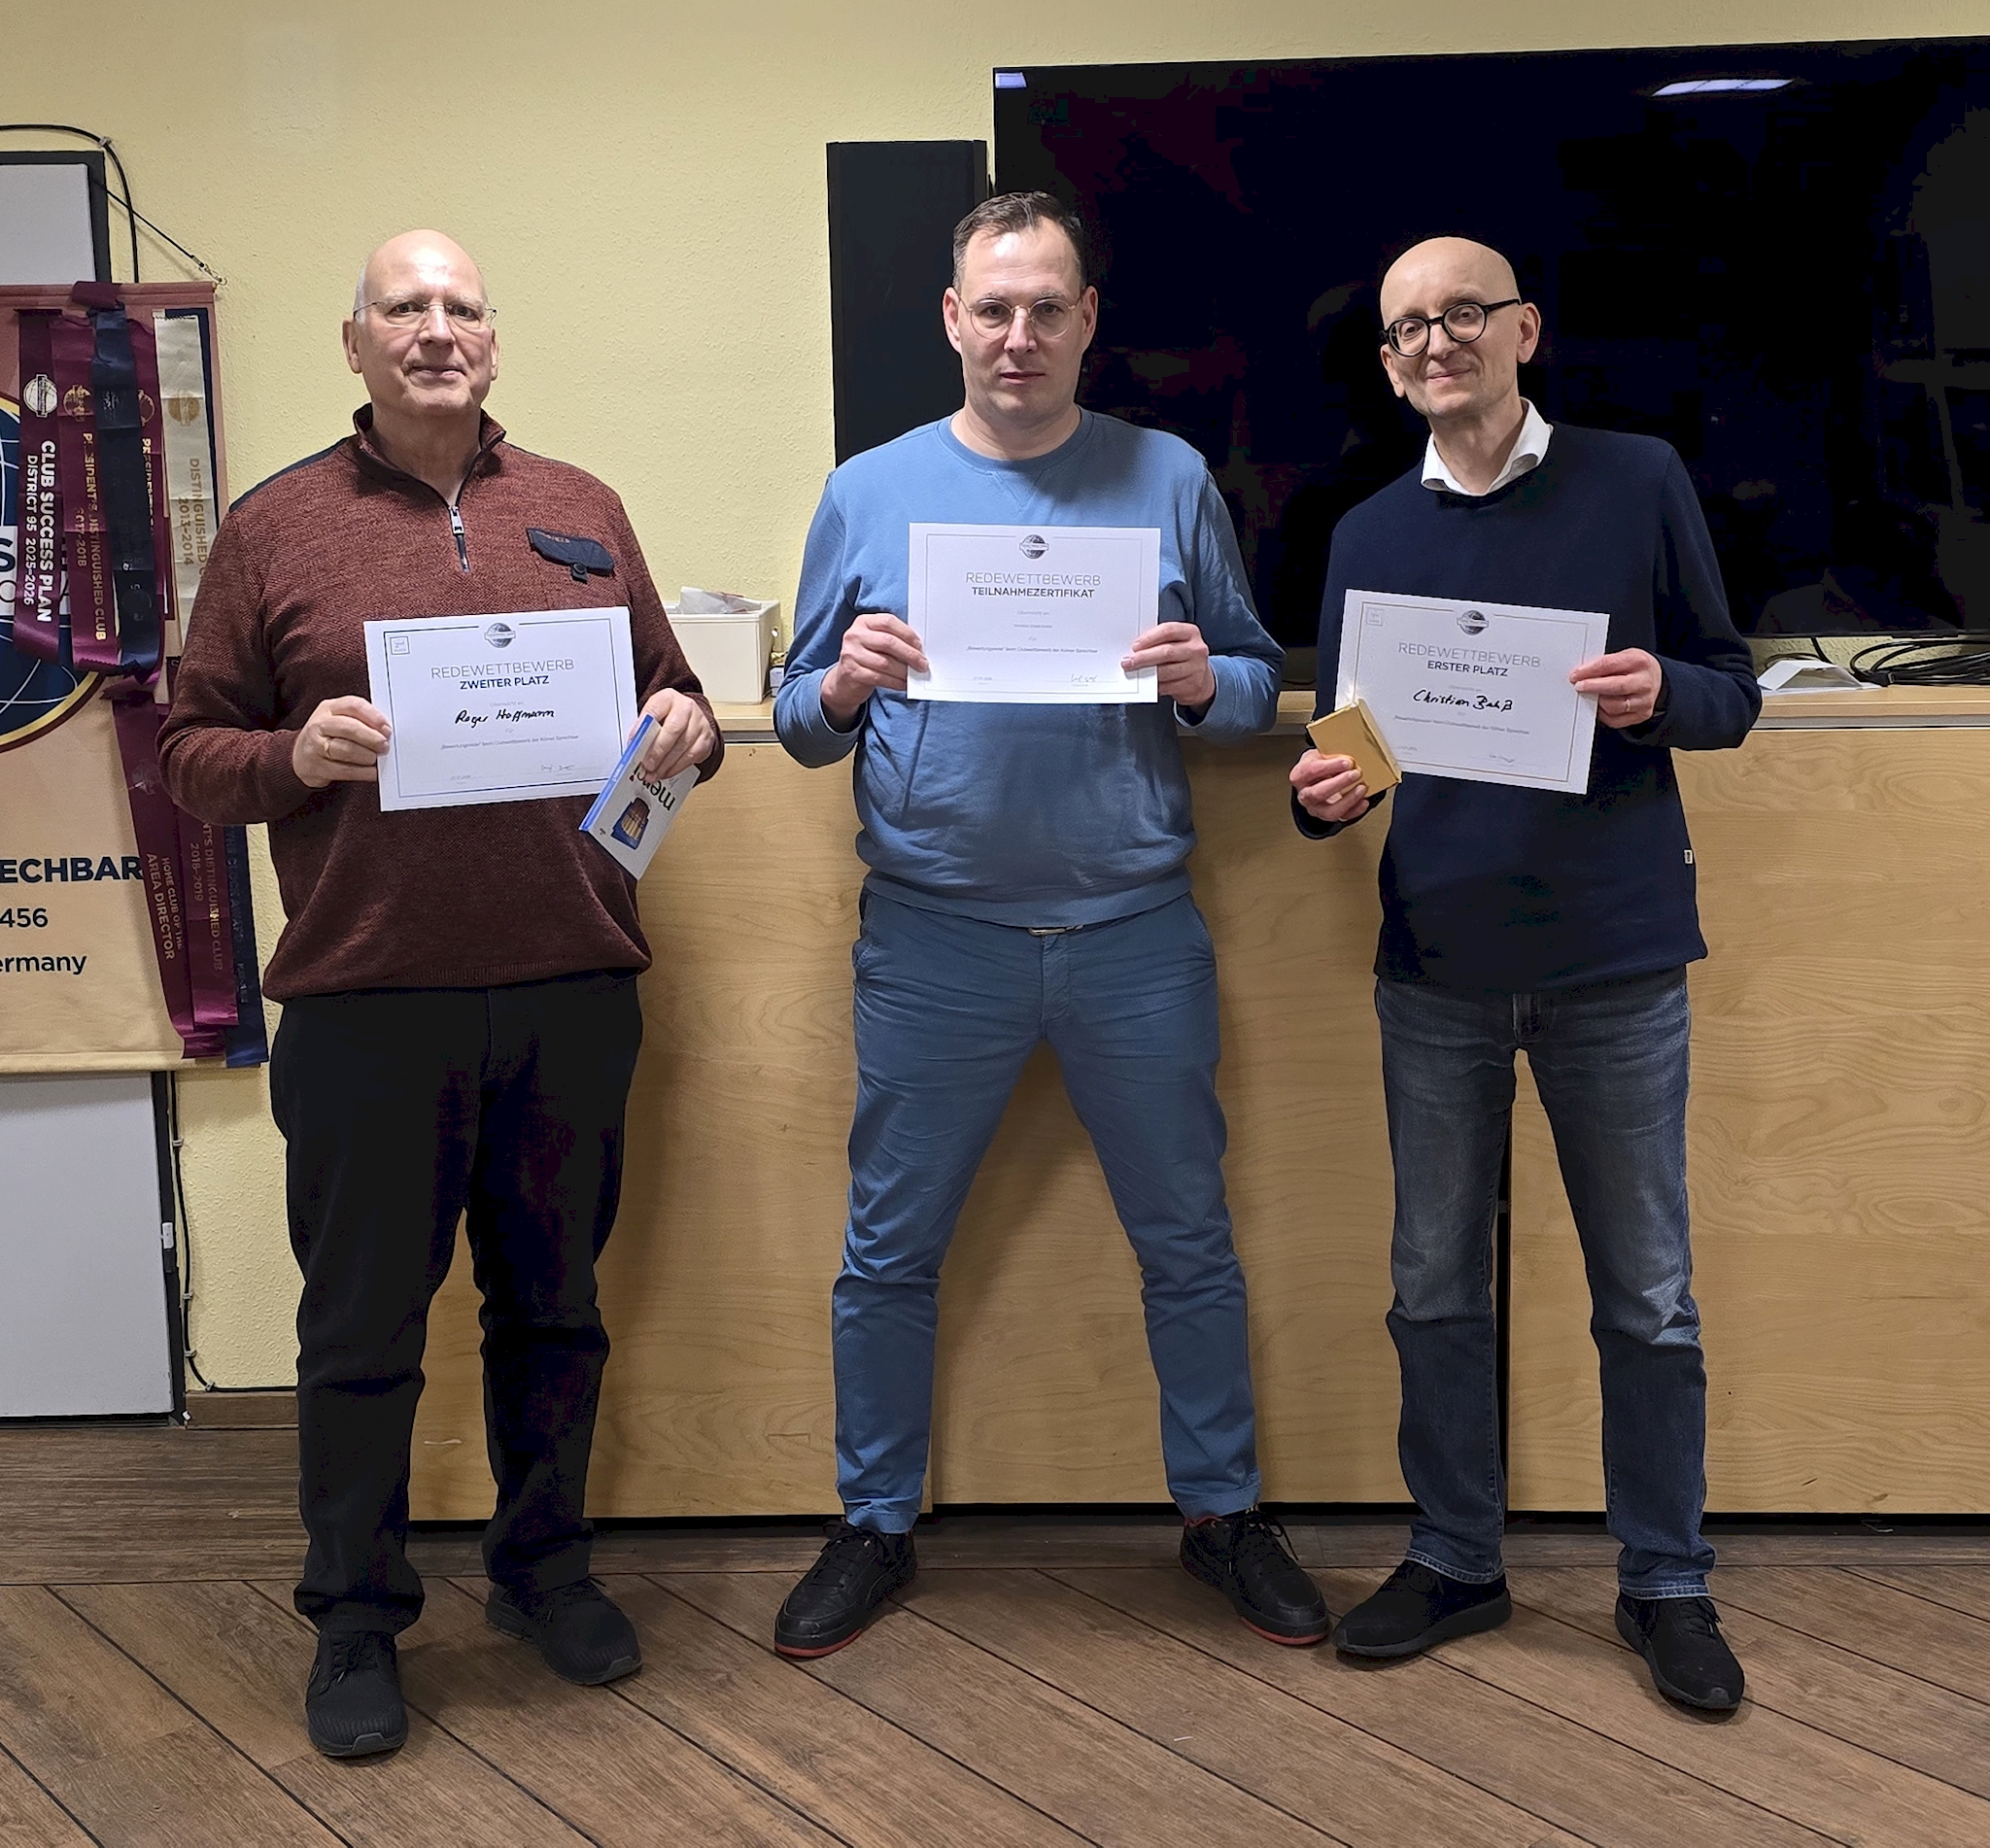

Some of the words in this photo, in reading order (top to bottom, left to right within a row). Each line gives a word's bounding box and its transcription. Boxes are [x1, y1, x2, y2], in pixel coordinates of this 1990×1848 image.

[40, 440, 55, 486] CLUB
[25, 455, 38, 511] DISTRICT
[26, 516, 38, 531] 95
[189, 458, 208, 564] DISTINGUISHED
[39, 493, 55, 570] SUCCESS
[83, 432, 98, 511] PSIDENT'S
[94, 607, 107, 640] CLUB
[179, 496, 194, 566] 2013-2014
[23, 537, 37, 606] 2025-2026
[966, 571, 1102, 587] REDEWETTBEWERB
[37, 574, 53, 623] PLAN
[972, 586, 1095, 599] TEILNAHMEZERTIFIKAT
[430, 658, 575, 679] REDEWETTBEWERB
[1397, 641, 1541, 668] REDEWETTBEWERB
[1427, 660, 1471, 674] ERSTER
[1473, 665, 1509, 677] PLATZ
[460, 677, 512, 691] ZWEITER
[514, 674, 550, 688] PLATZ
[1413, 689, 1470, 707] Christian
[454, 709, 489, 729] Roger
[495, 707, 556, 723] Hoffmann
[146, 853, 163, 890] AREA
[161, 857, 175, 886] HOME
[189, 842, 204, 903] 2018-2019
[167, 887, 180, 913] CLUB
[154, 892, 176, 960] DIRECTOR
[0, 955, 87, 975] rmany
[211, 940, 223, 972] CLUB
